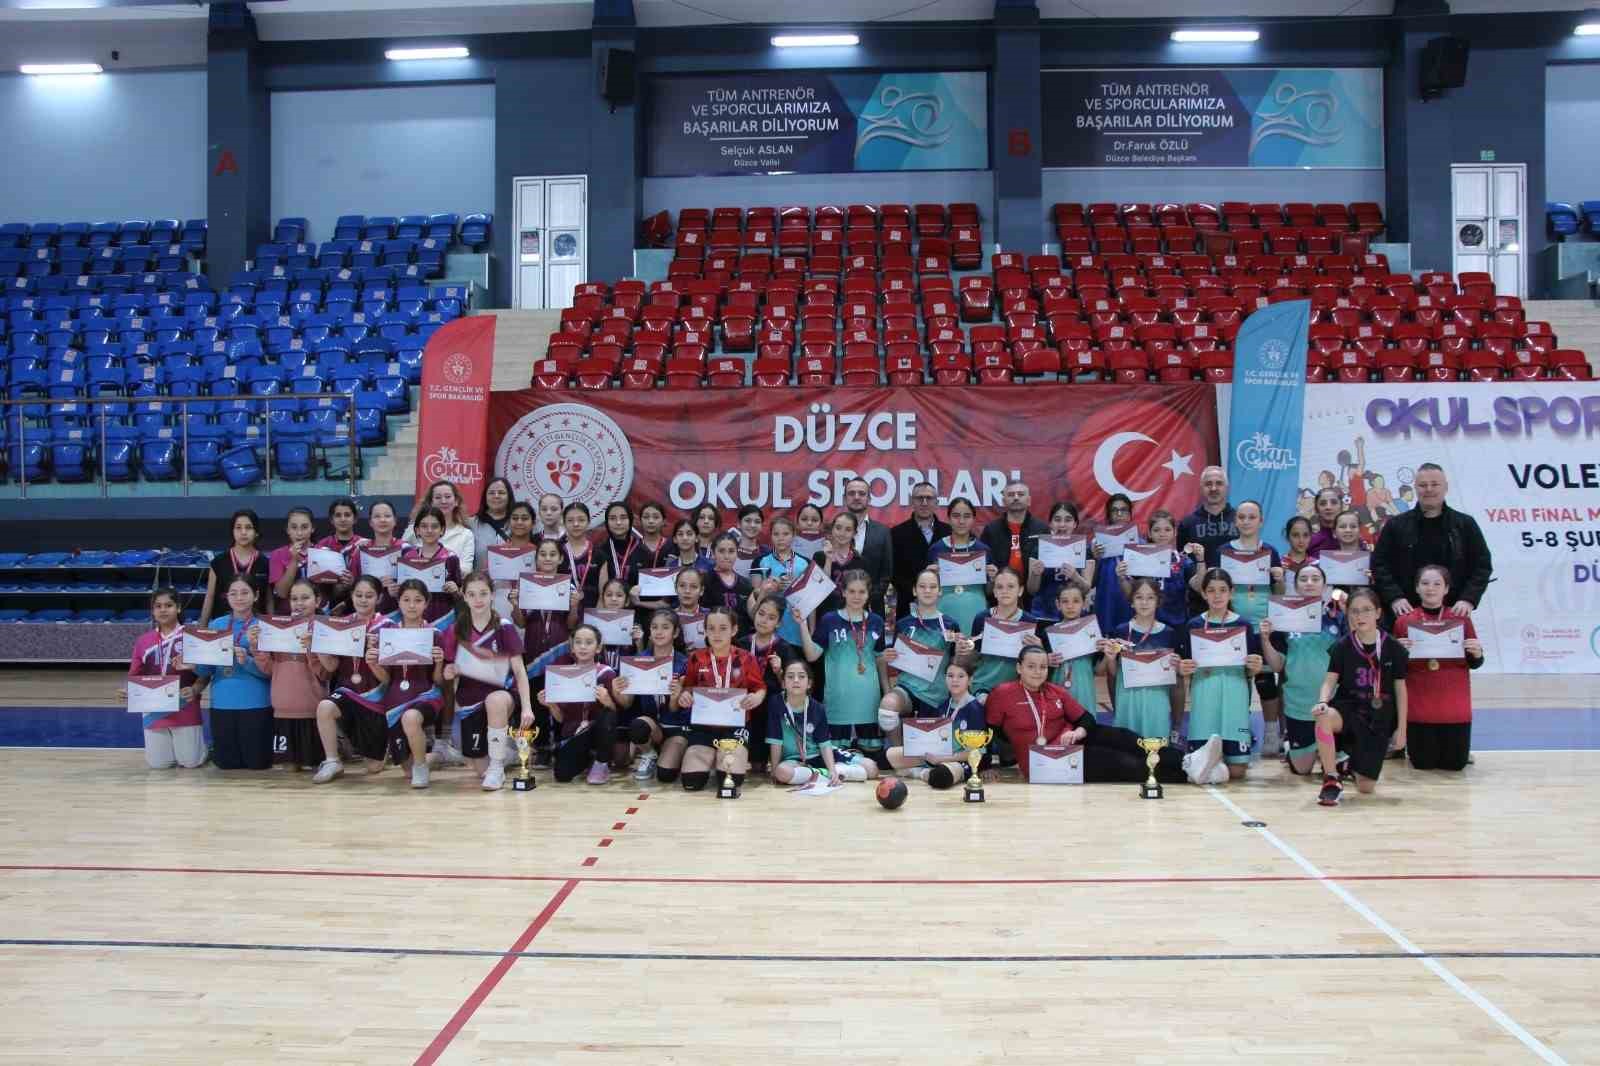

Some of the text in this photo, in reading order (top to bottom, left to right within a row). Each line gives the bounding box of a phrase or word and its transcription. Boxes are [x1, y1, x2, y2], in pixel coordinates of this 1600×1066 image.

[707, 87, 815, 101] TÜM ANTRENÖR
[1101, 82, 1209, 96] TÜM ANTRENÖR
[692, 101, 831, 117] VE SPORCULARIMIZA
[1084, 97, 1226, 111] VE SPORCULARIMIZA
[683, 116, 840, 137] BAŞARILAR DİLİYORUM
[1076, 111, 1234, 130] BAŞARILAR DİLİYORUM
[720, 144, 793, 158] Selçuk ASLAN
[1159, 138, 1189, 151] ÖZLÜ
[1365, 396, 1491, 441] OKUL
[774, 402, 917, 452] DÜZCE
[1507, 463, 1600, 489] VOLE
[669, 467, 1021, 511] OKUL SPORLAR
[1486, 508, 1527, 522] YARI
[1521, 530, 1600, 552] 5-8 ŞU
[833, 628, 848, 643] 14
[273, 735, 287, 752] 12
[472, 733, 480, 748] 7
